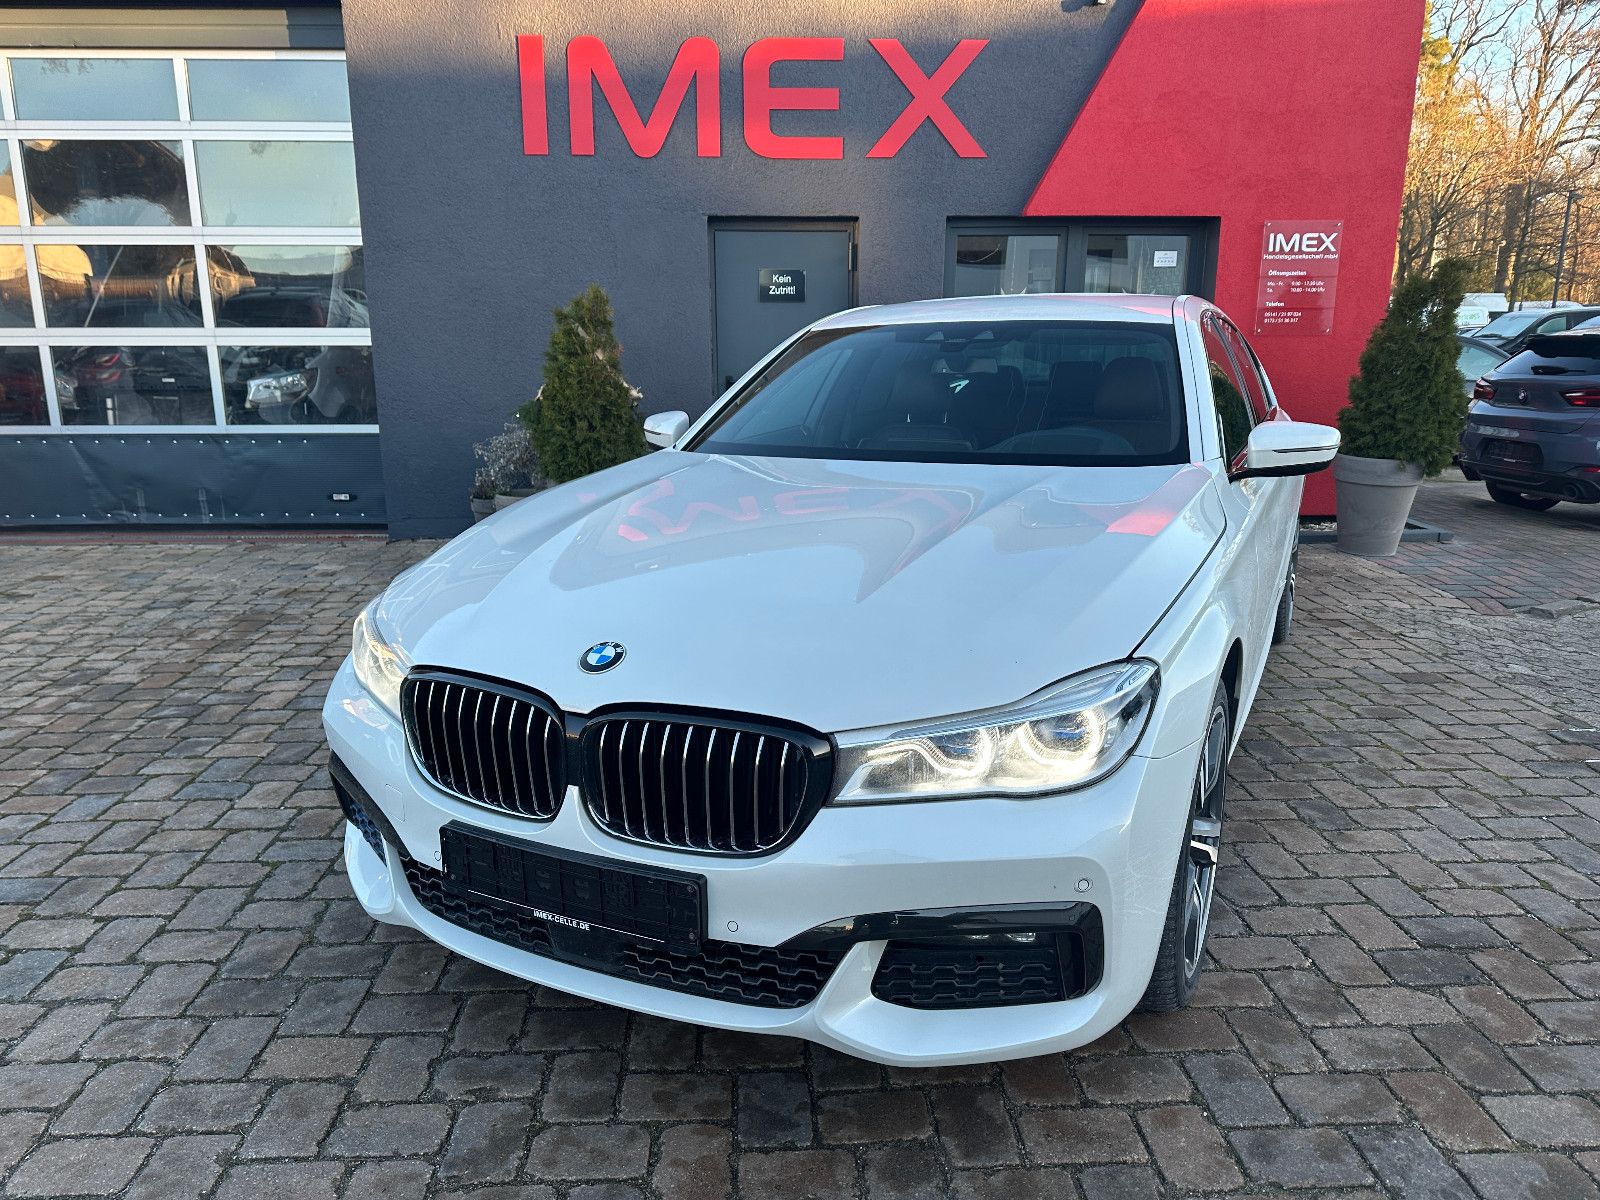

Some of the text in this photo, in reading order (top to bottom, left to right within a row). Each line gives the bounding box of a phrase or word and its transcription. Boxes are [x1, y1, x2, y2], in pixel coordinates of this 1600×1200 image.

[517, 34, 990, 158] IMEX
[1267, 232, 1338, 252] IMEX
[772, 274, 792, 283] Kein
[769, 285, 796, 295] Zutritt!
[533, 909, 591, 931] IMEX-CELLE.DE
